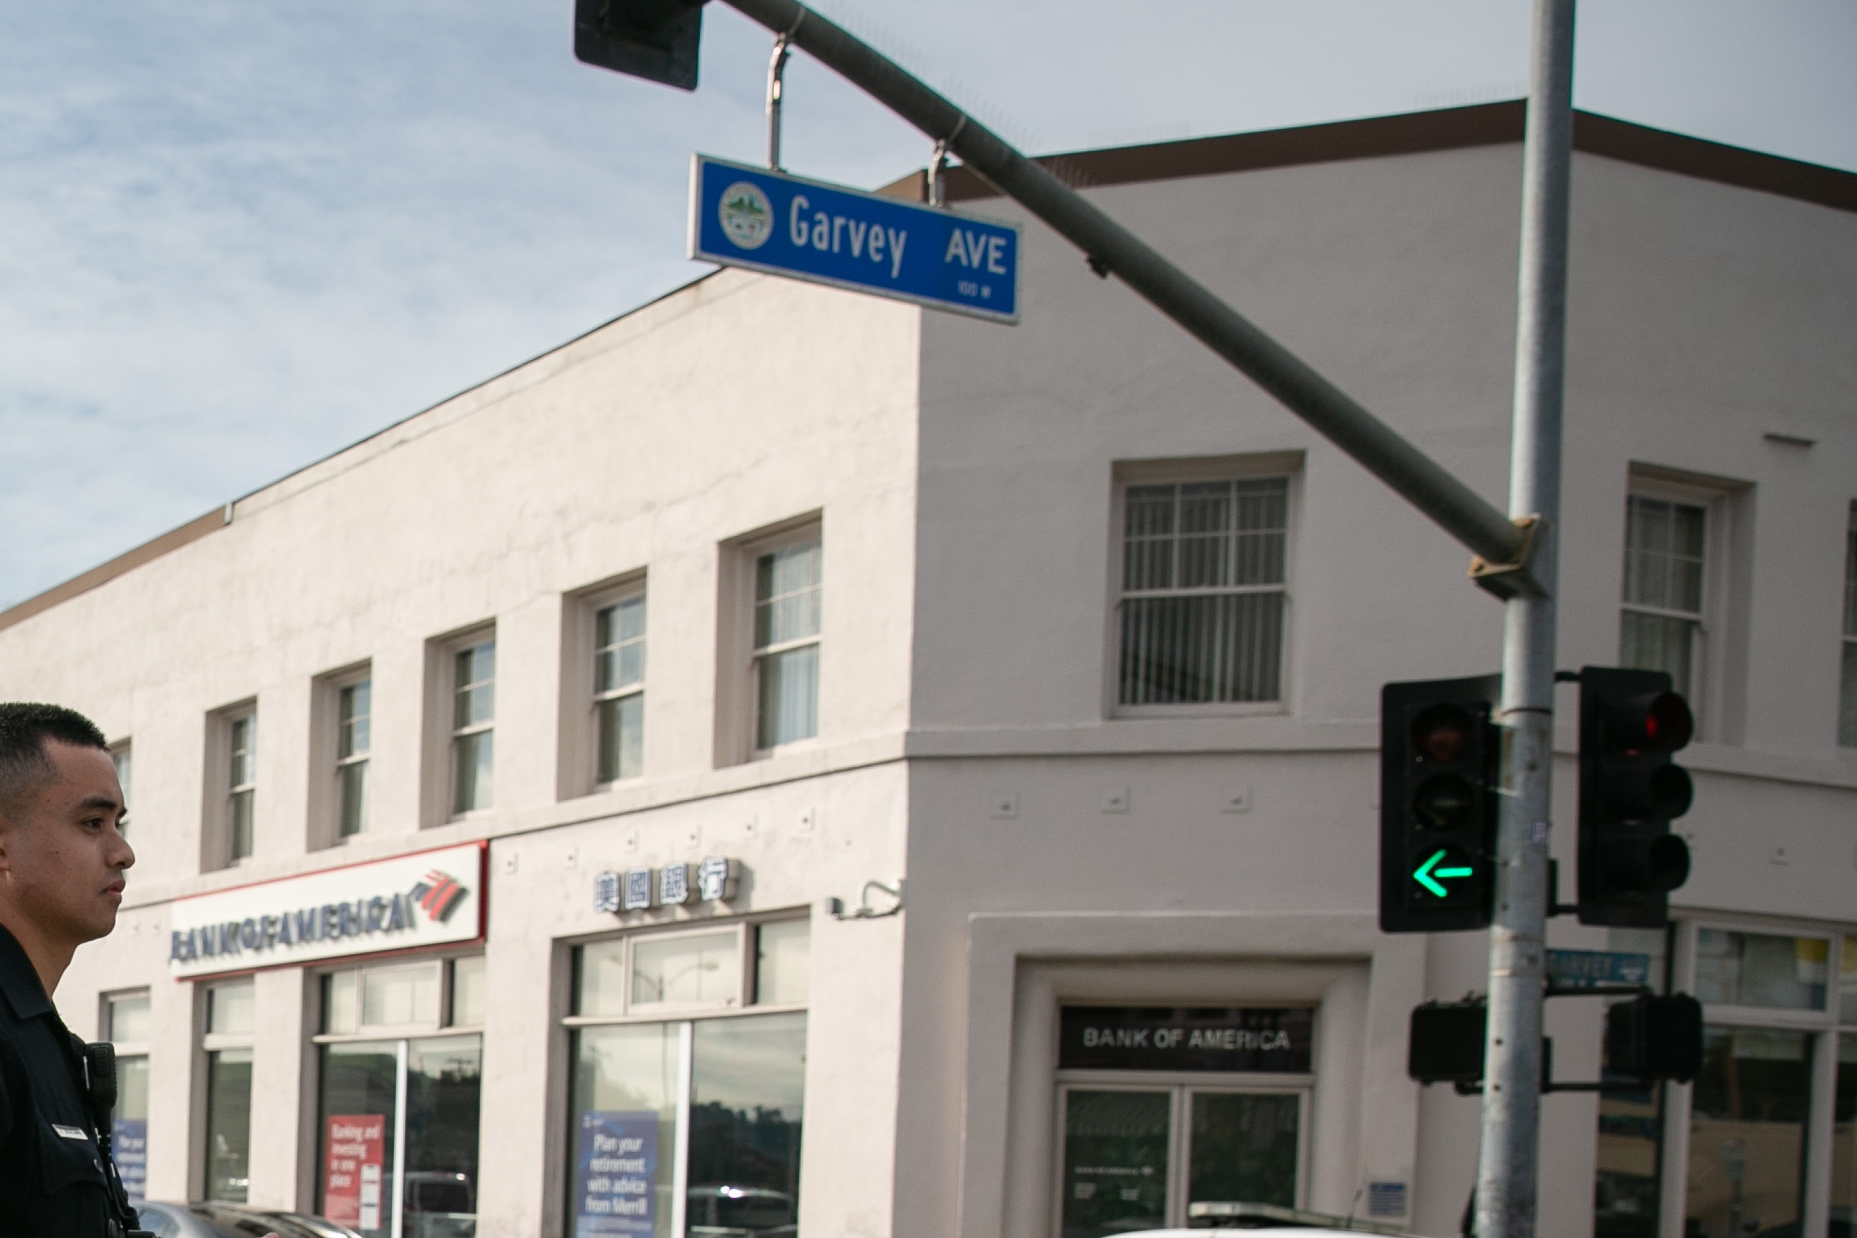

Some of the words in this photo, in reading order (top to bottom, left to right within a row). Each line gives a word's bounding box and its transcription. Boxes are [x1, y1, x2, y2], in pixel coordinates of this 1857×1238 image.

[789, 195, 907, 279] Garvey
[945, 228, 1008, 275] AVE
[1083, 1027, 1148, 1048] BANK
[1153, 1028, 1184, 1049] OF
[1188, 1028, 1291, 1050] AMERICA
[593, 1133, 617, 1151] Plan
[617, 1137, 644, 1156] your
[589, 1156, 646, 1174] retirement
[587, 1176, 610, 1193] with
[612, 1176, 647, 1195] advice
[585, 1195, 609, 1214] from
[612, 1197, 648, 1215] Merrill
